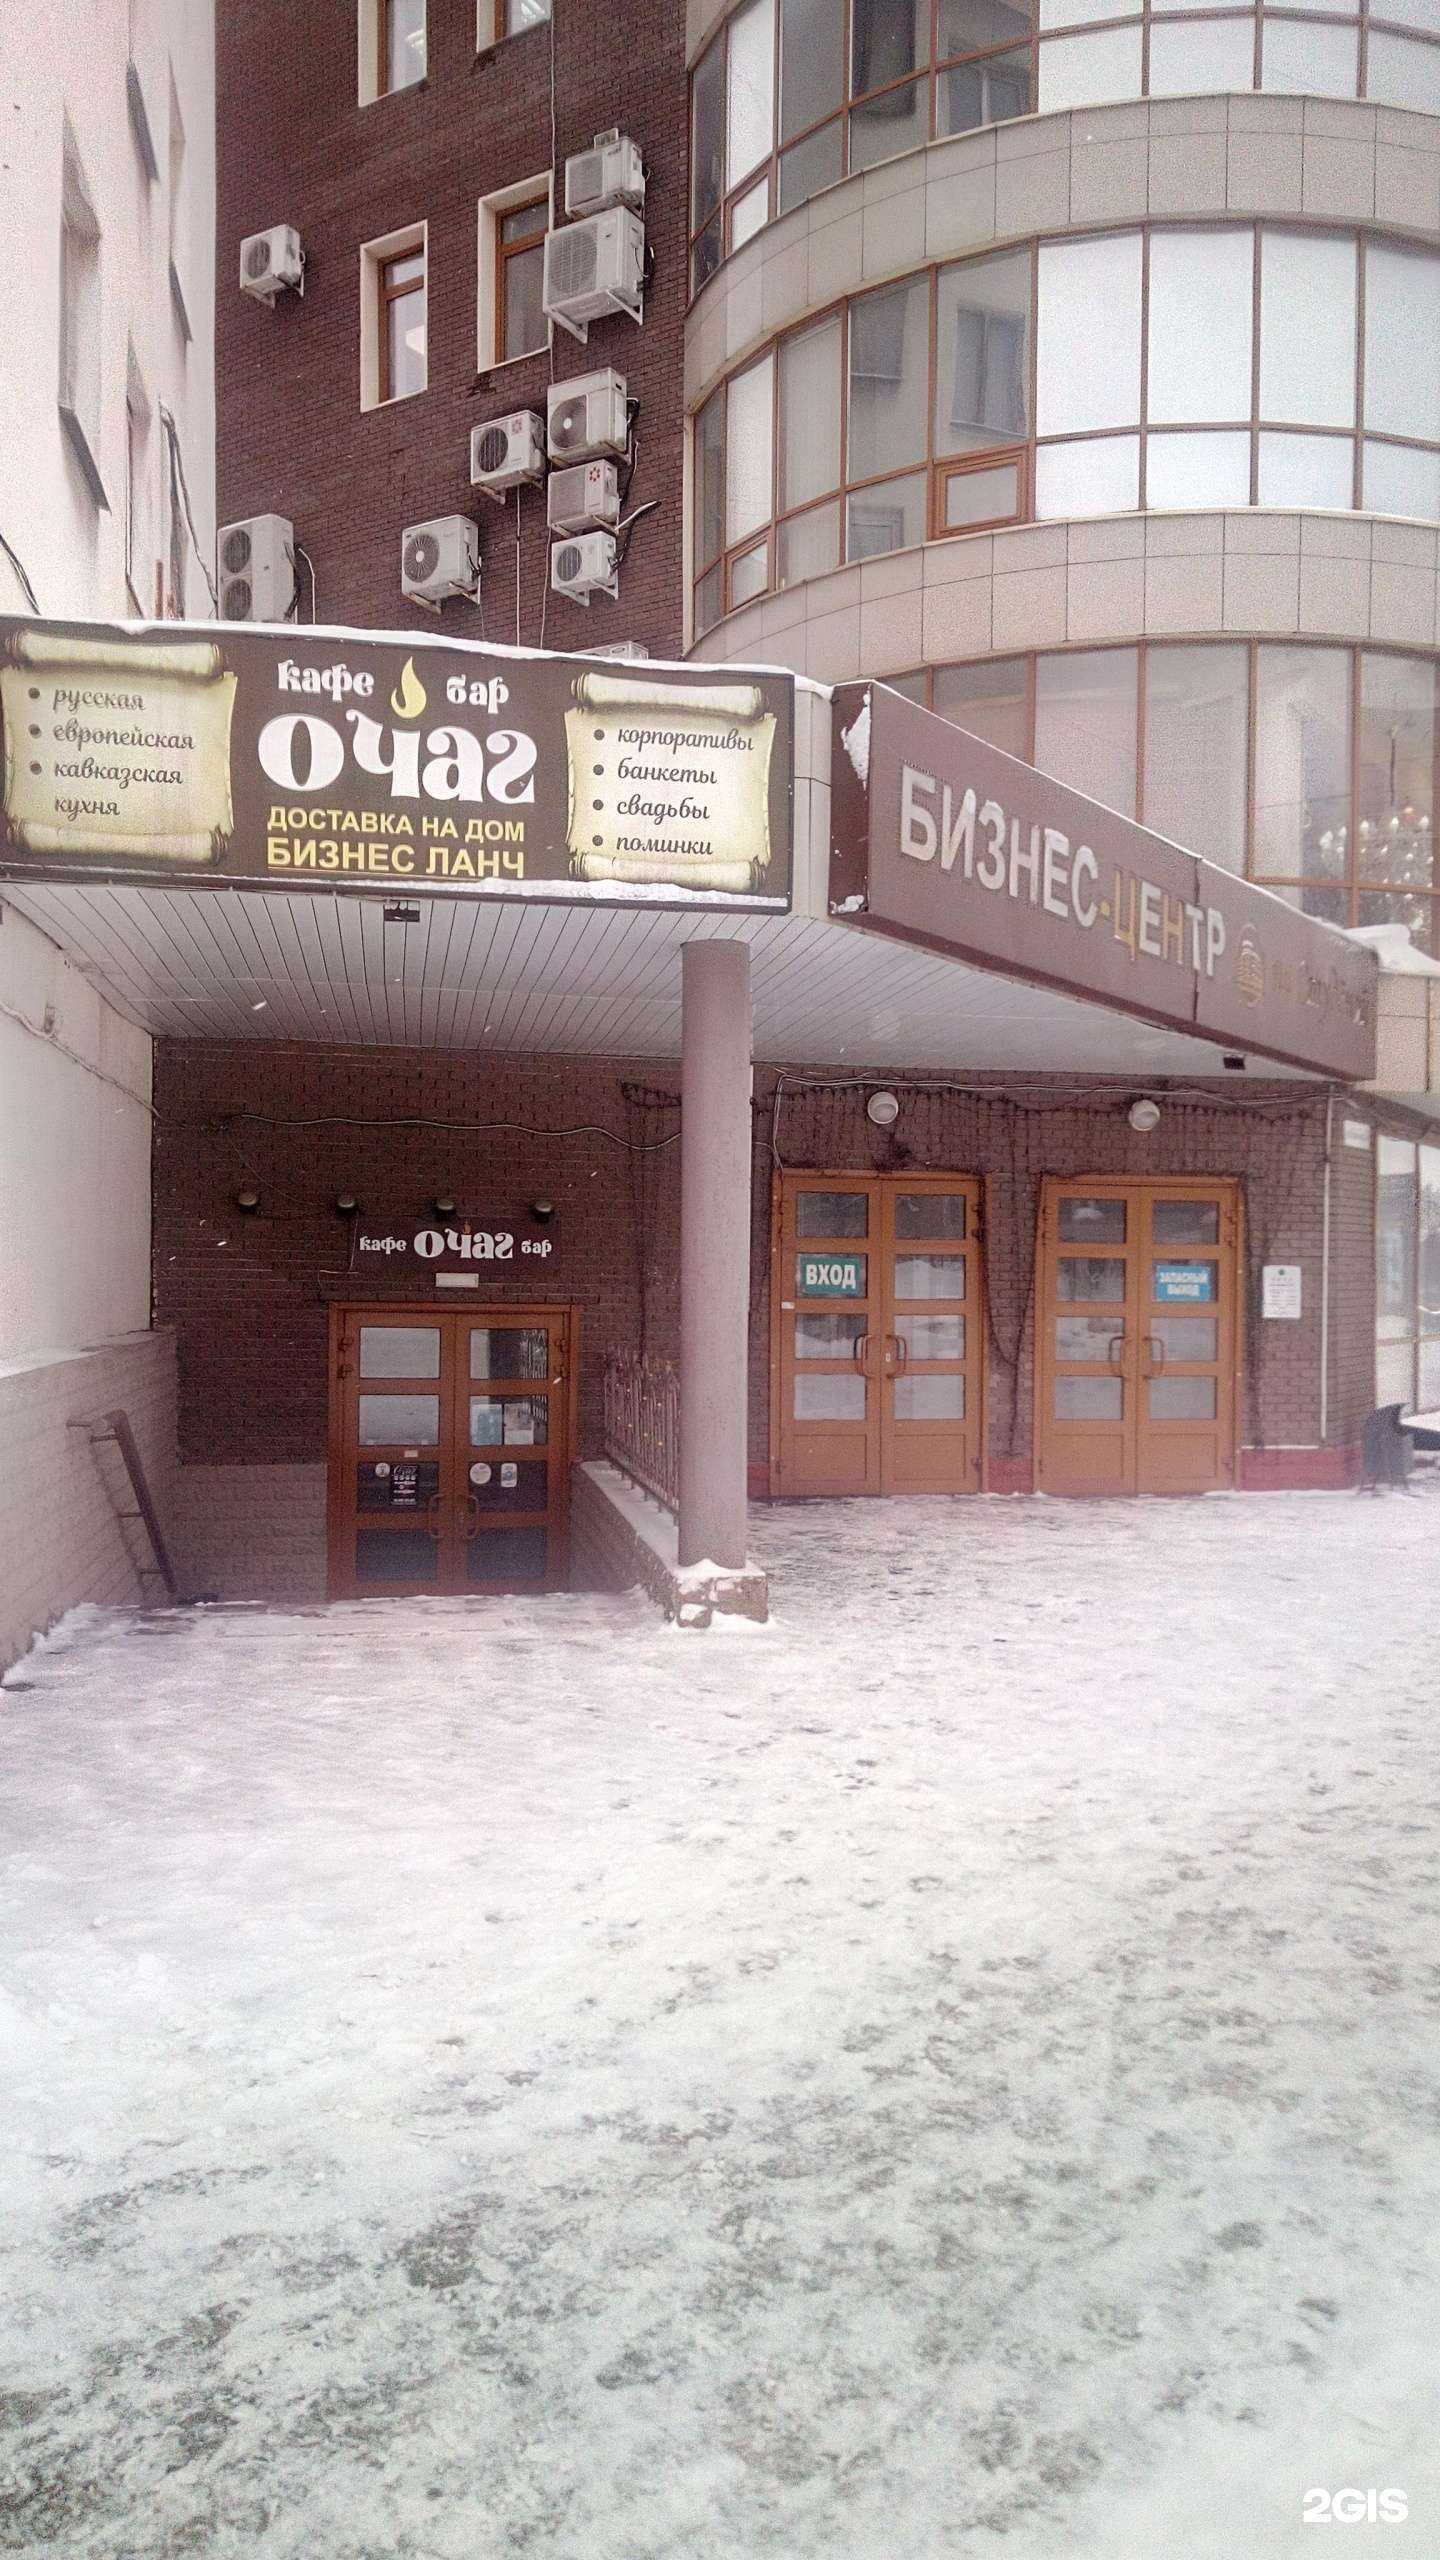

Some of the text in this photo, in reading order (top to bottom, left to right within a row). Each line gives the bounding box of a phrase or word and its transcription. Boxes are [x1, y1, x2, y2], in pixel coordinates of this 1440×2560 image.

[53, 688, 146, 714] русская
[277, 659, 510, 714] кафе бар
[53, 718, 196, 751] европейская
[617, 728, 754, 755] корпоративы
[54, 757, 184, 789] кавказская
[617, 757, 718, 784] банкеты
[54, 797, 121, 821] кухня
[616, 794, 711, 825] свадьбы
[267, 806, 525, 843] ДОСТАВКА НА ДОМ
[267, 837, 525, 879] БИЗНЕС ЛАНЧ
[616, 836, 714, 856] поминки
[901, 764, 1227, 977] БИЗНЕС-ЦЕНТР
[359, 1236, 407, 1255] кафе
[521, 1239, 552, 1257] бар
[805, 1264, 857, 1289] ВХОД
